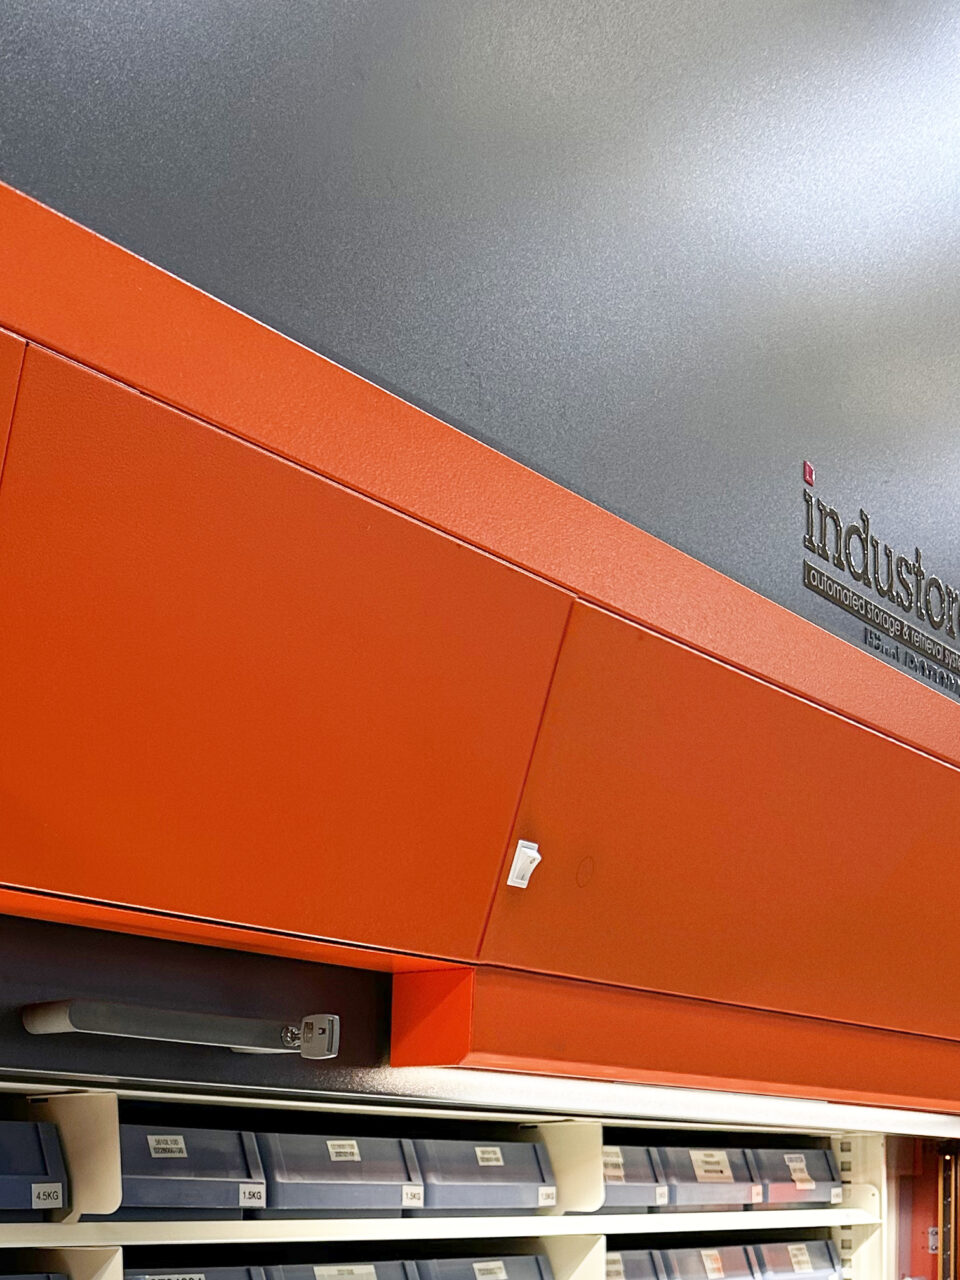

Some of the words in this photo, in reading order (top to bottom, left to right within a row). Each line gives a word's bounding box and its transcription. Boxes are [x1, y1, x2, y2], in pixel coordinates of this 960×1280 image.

[803, 460, 960, 640] industor
[809, 569, 866, 615] automated
[866, 603, 901, 637] storage
[902, 621, 910, 640] &
[910, 629, 944, 662] retrieval
[35, 1190, 59, 1201] 4.5KG
[242, 1190, 262, 1200] 1.5KG
